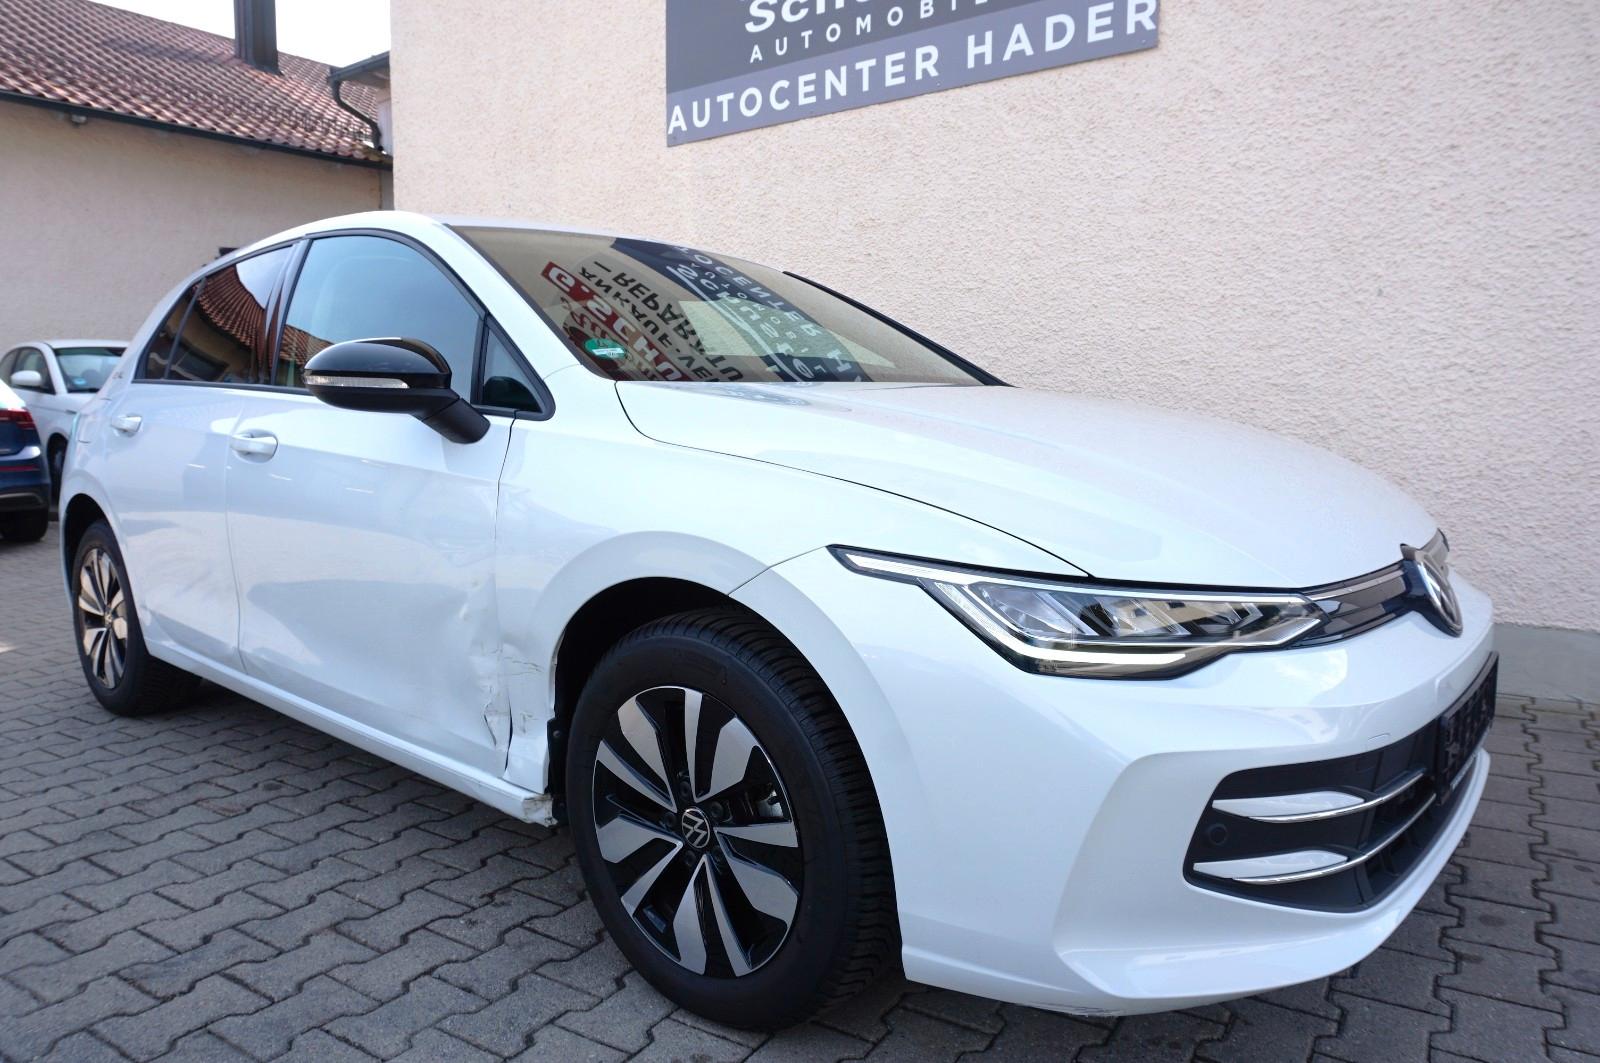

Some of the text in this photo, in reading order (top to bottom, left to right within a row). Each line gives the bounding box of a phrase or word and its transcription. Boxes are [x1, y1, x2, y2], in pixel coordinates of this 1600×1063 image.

[667, 0, 1157, 135] AUTOCENTER HADER
[750, 0, 988, 64] AUTOMOBI
